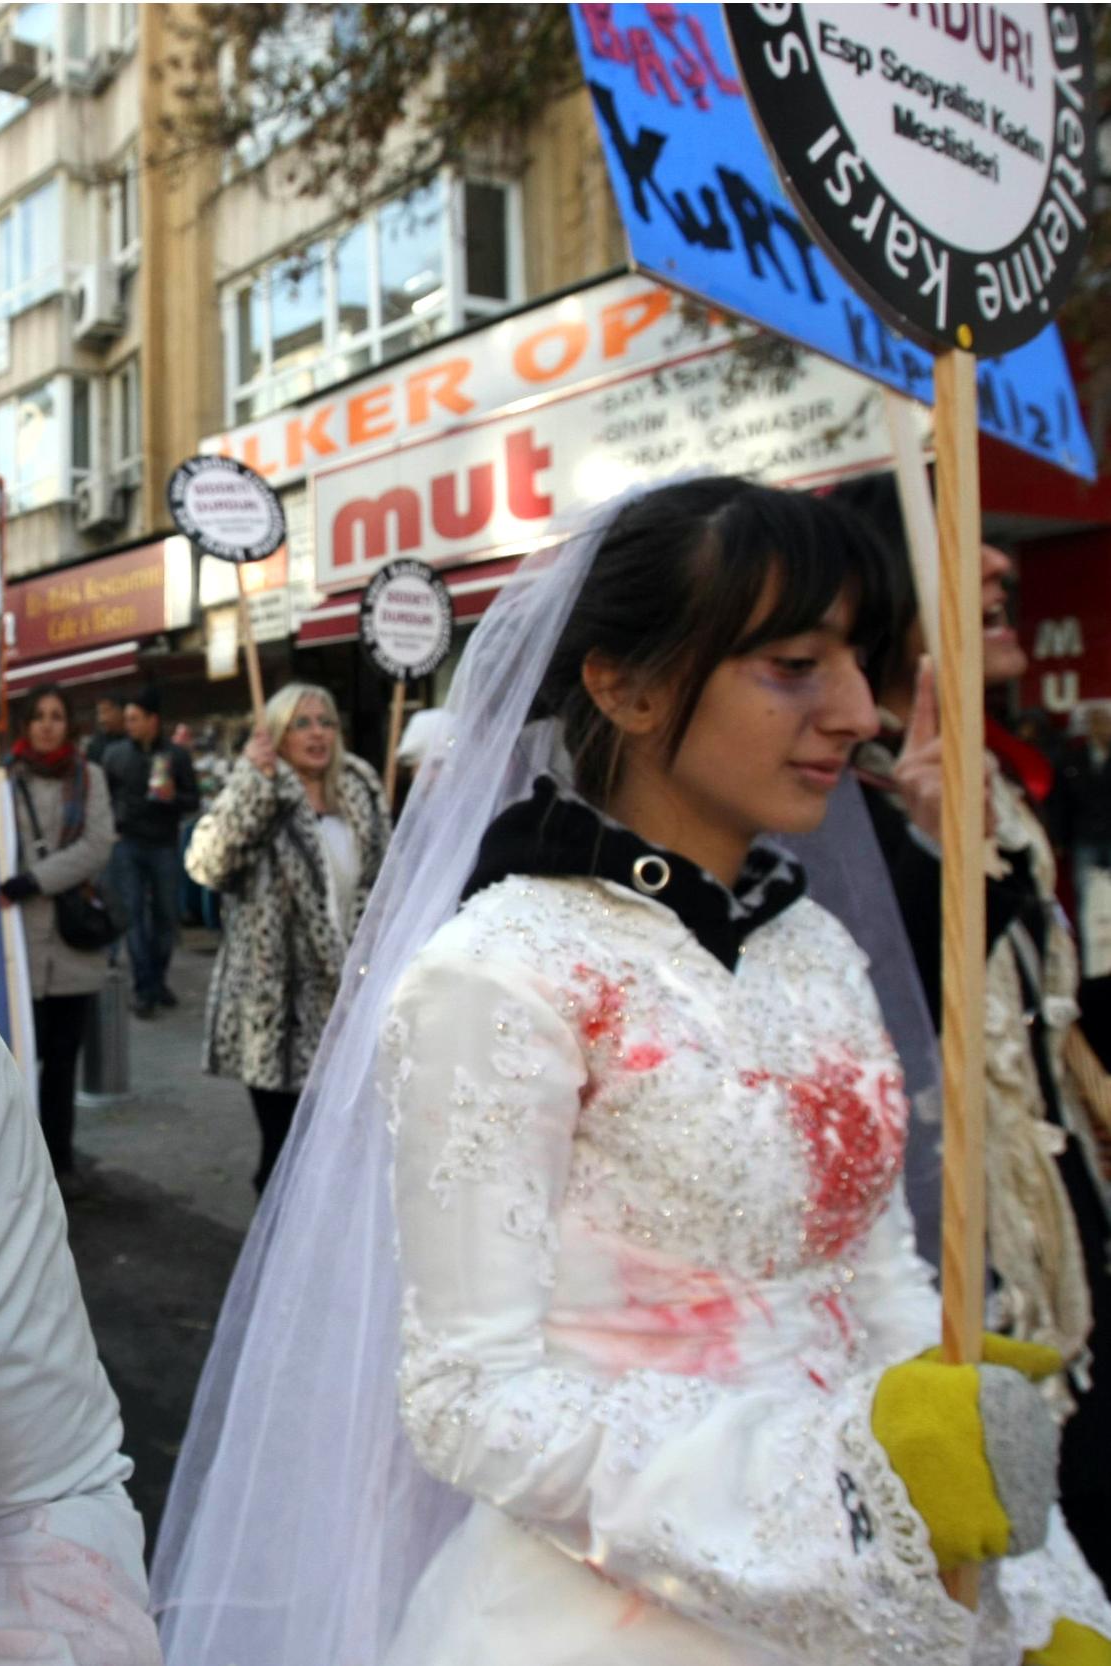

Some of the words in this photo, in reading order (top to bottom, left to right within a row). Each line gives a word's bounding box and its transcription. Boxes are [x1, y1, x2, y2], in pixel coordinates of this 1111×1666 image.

[819, 19, 872, 77] Esp
[880, 47, 987, 128] Sosyalist
[975, 5, 1087, 322] ayetlerine
[511, 286, 672, 385] OP
[332, 426, 556, 568] mut
